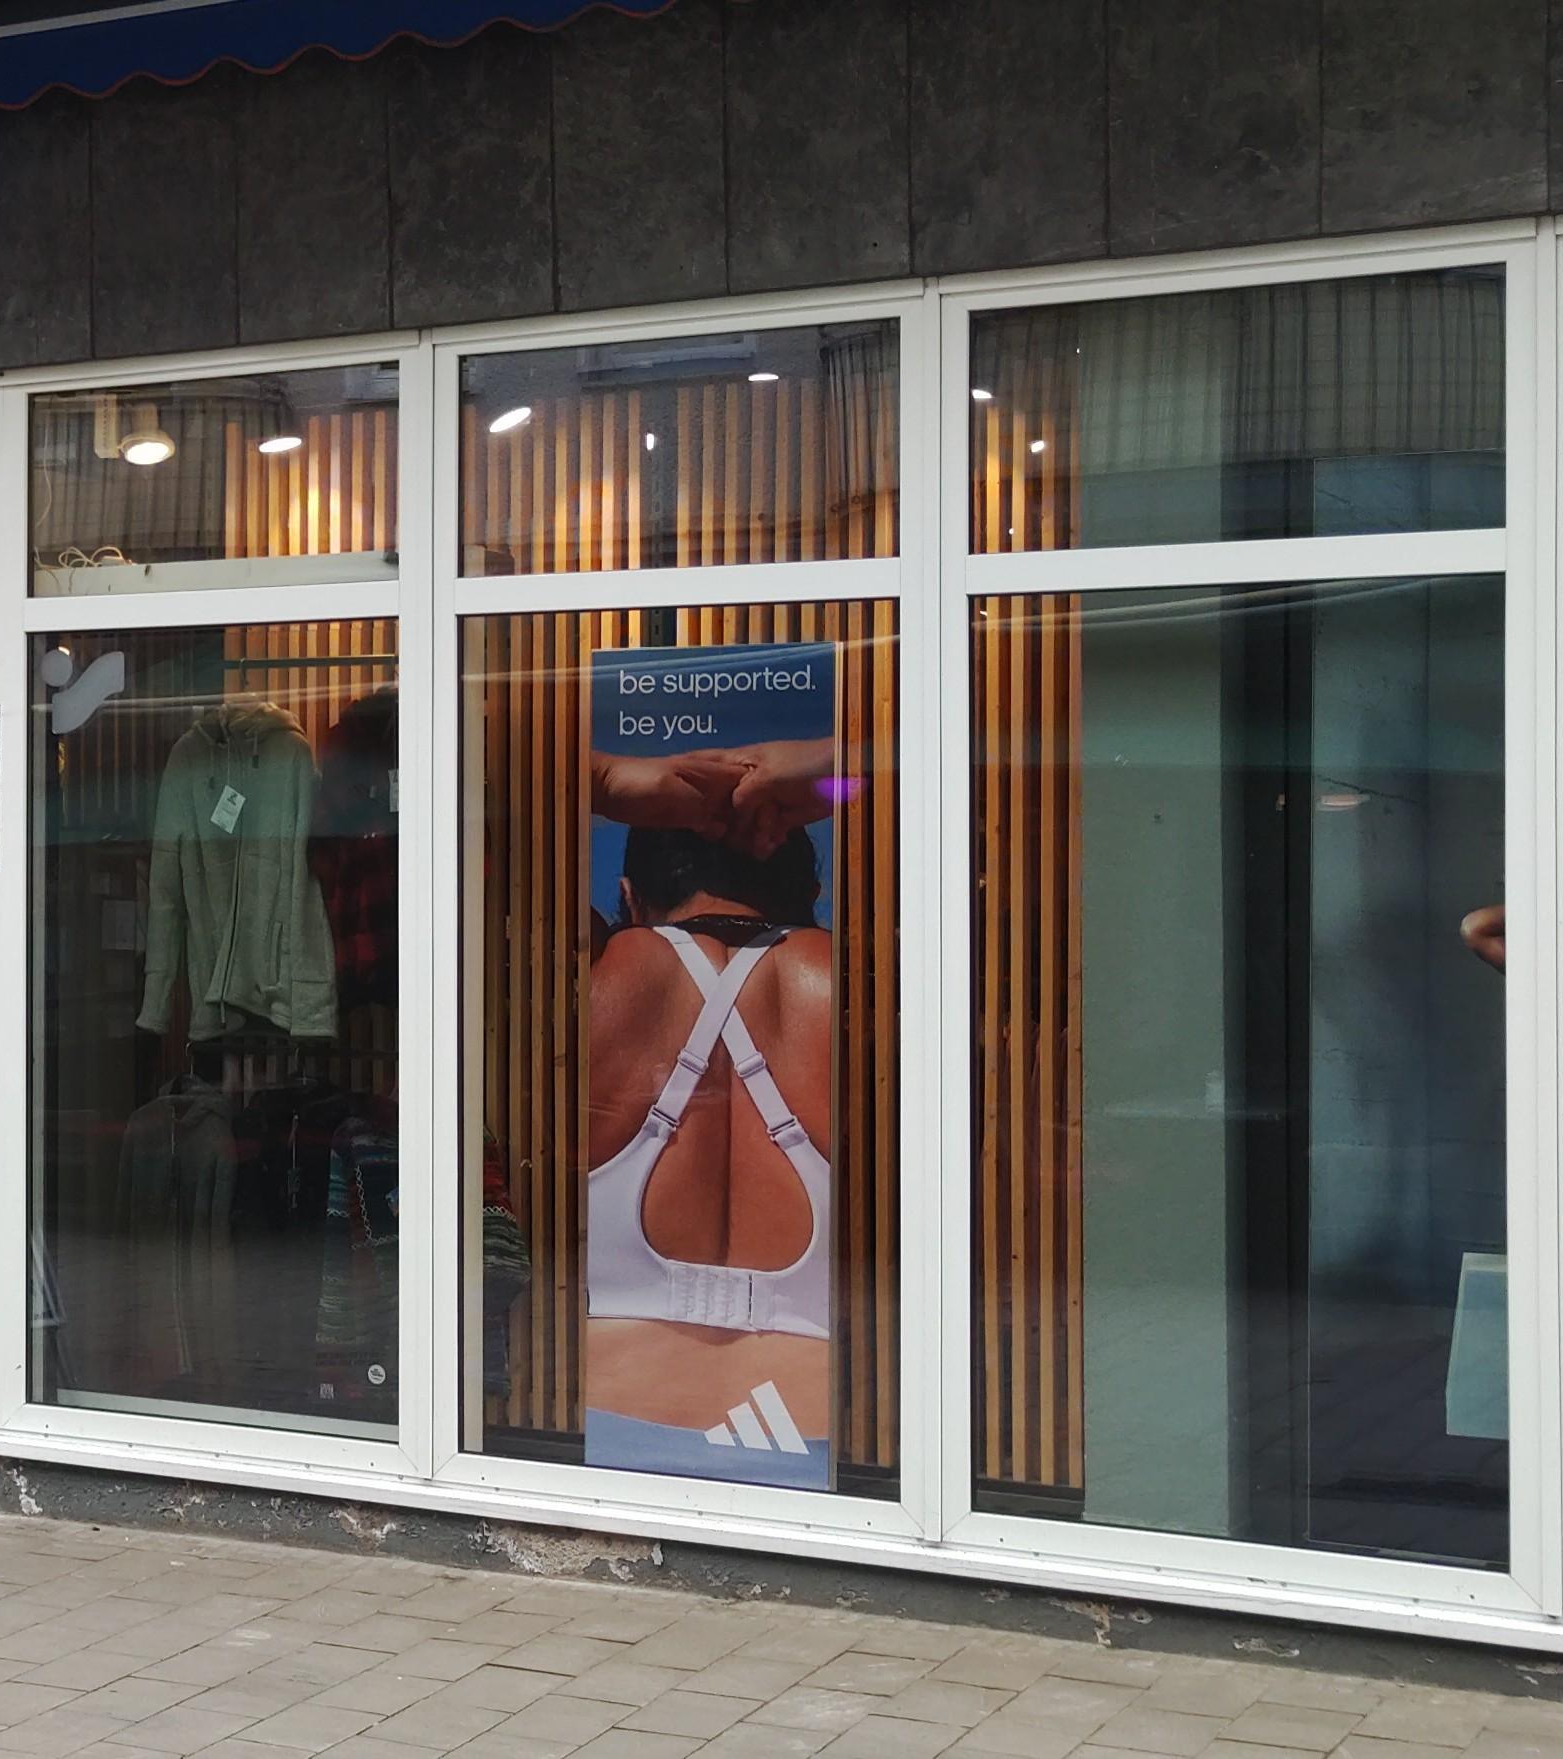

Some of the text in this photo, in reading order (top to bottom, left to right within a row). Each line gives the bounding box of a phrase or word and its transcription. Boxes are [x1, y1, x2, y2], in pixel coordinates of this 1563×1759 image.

[619, 664, 816, 699] be supported.
[619, 710, 719, 741] be you.
